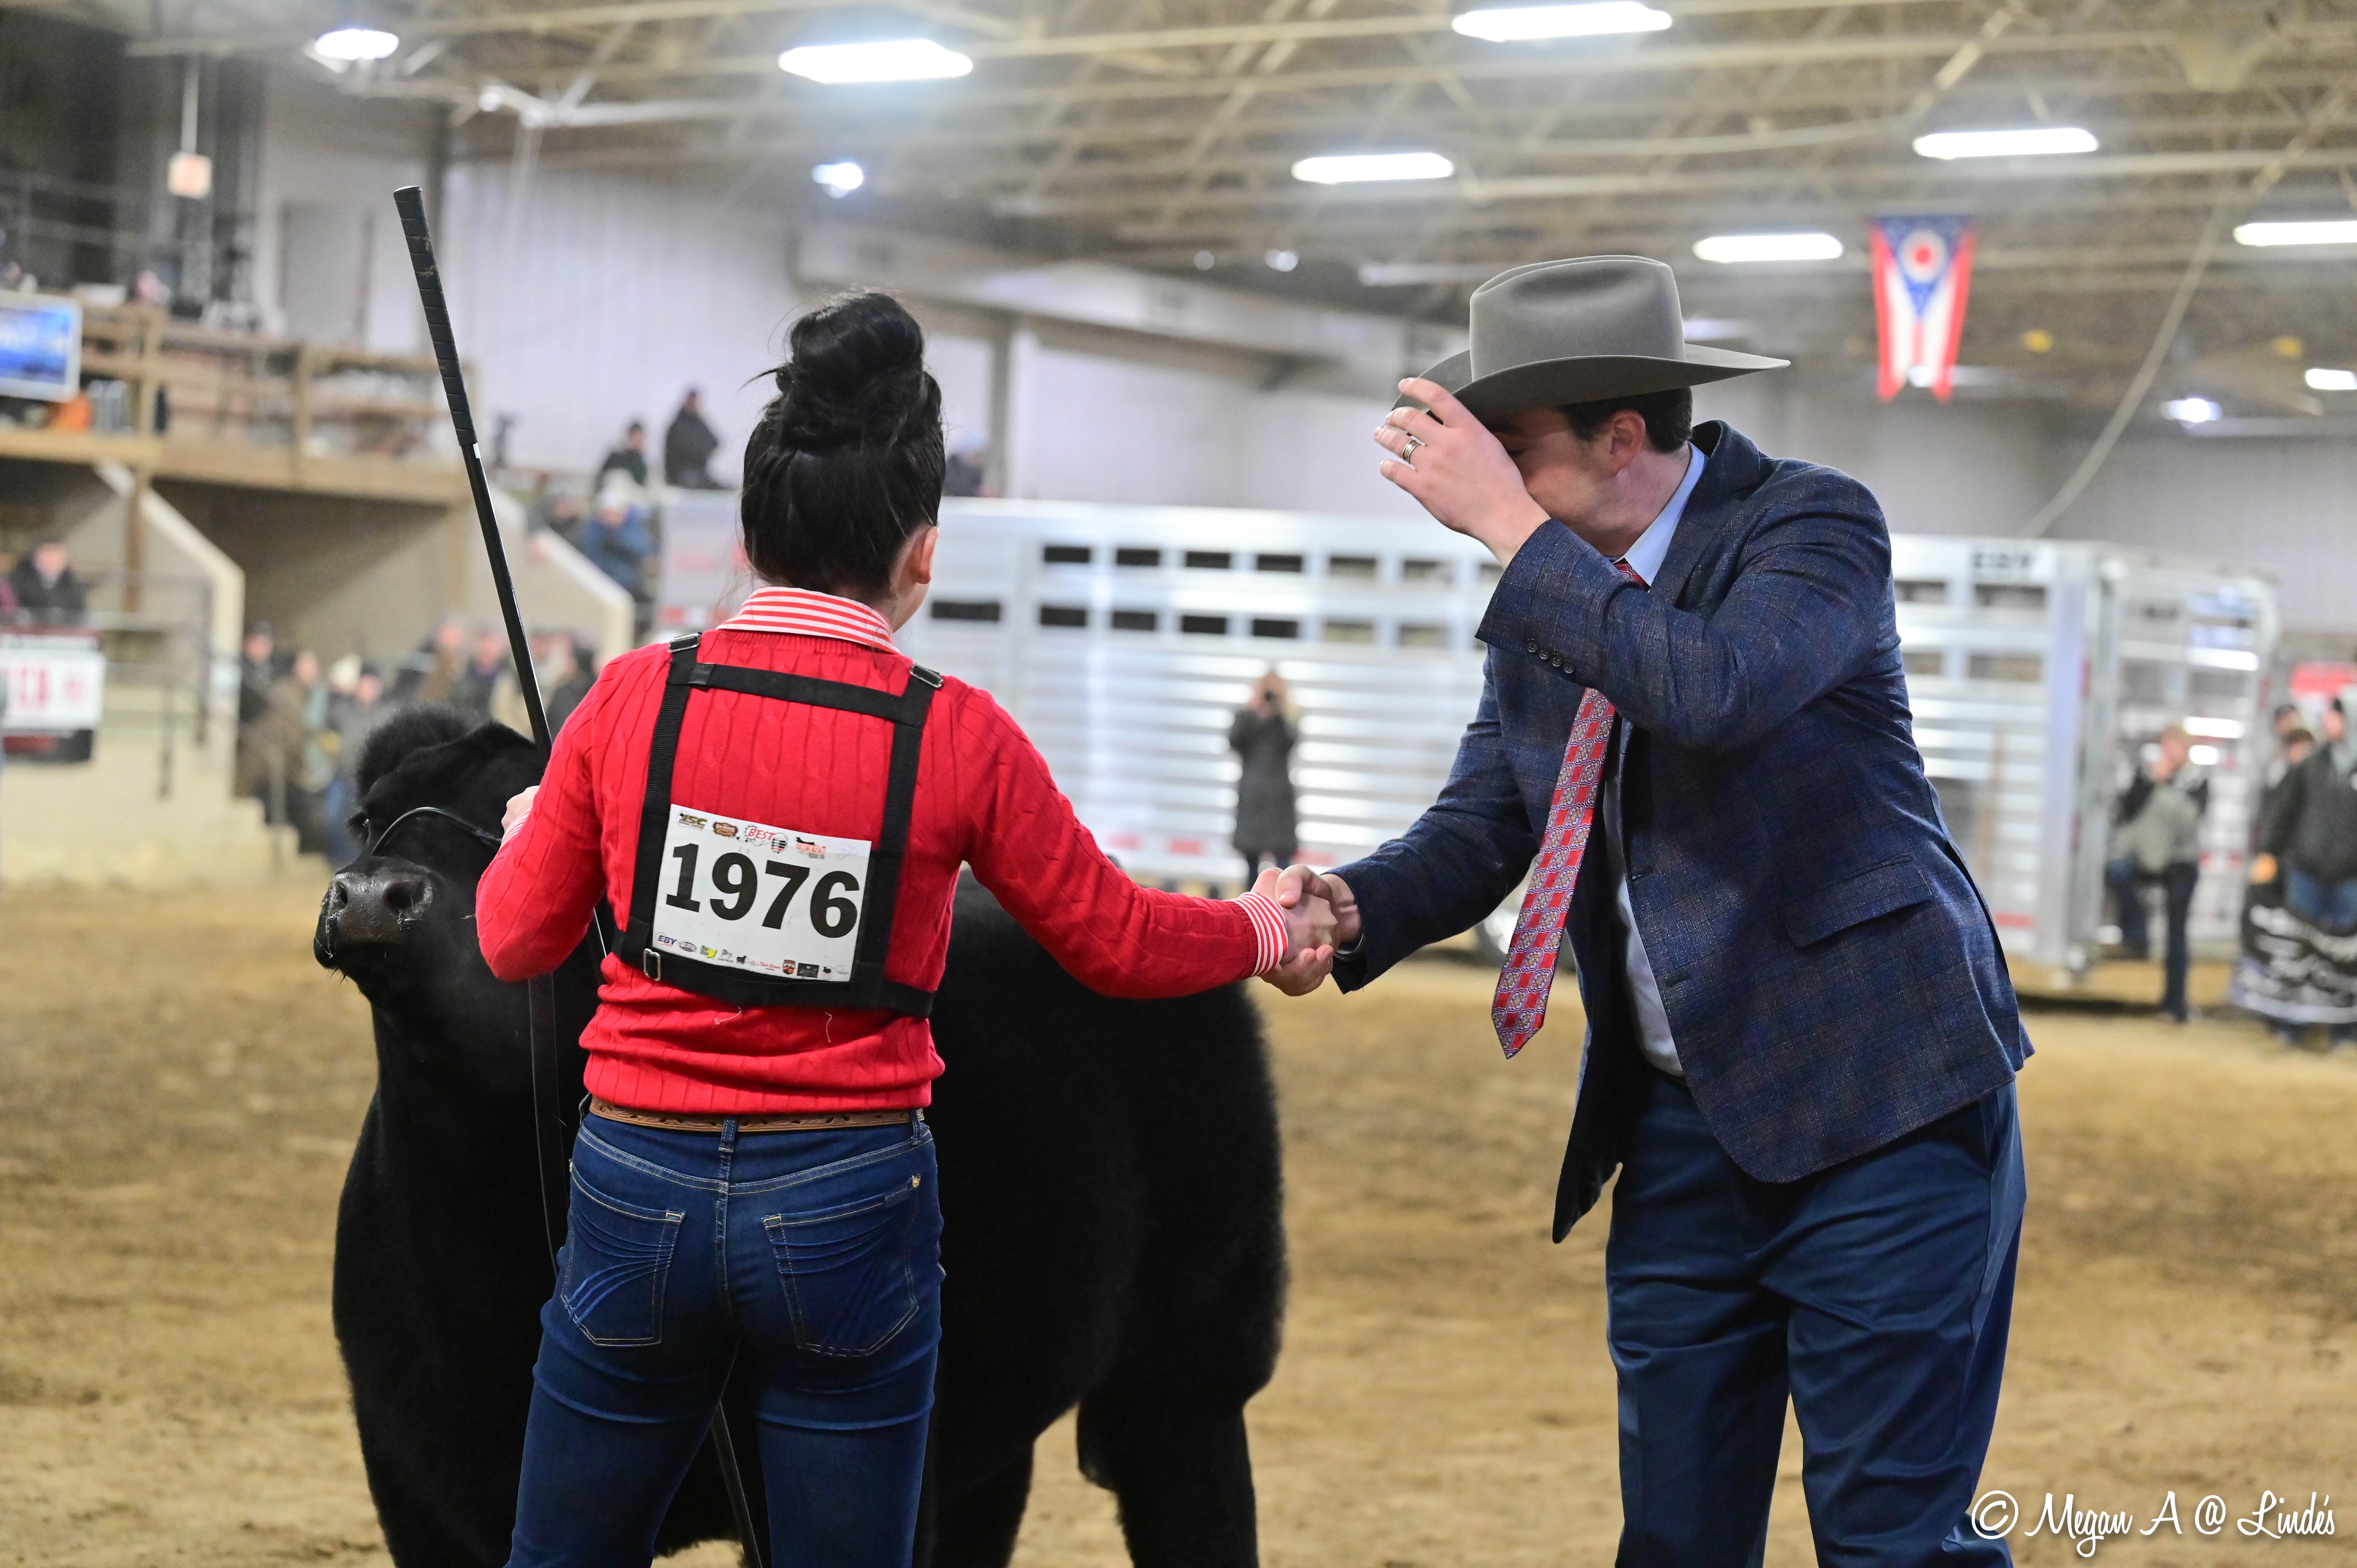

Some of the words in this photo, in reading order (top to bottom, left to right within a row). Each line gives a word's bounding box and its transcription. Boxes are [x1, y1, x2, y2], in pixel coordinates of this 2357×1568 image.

[748, 828, 776, 840] BEST
[666, 843, 860, 938] 1976
[658, 935, 677, 945] EBY
